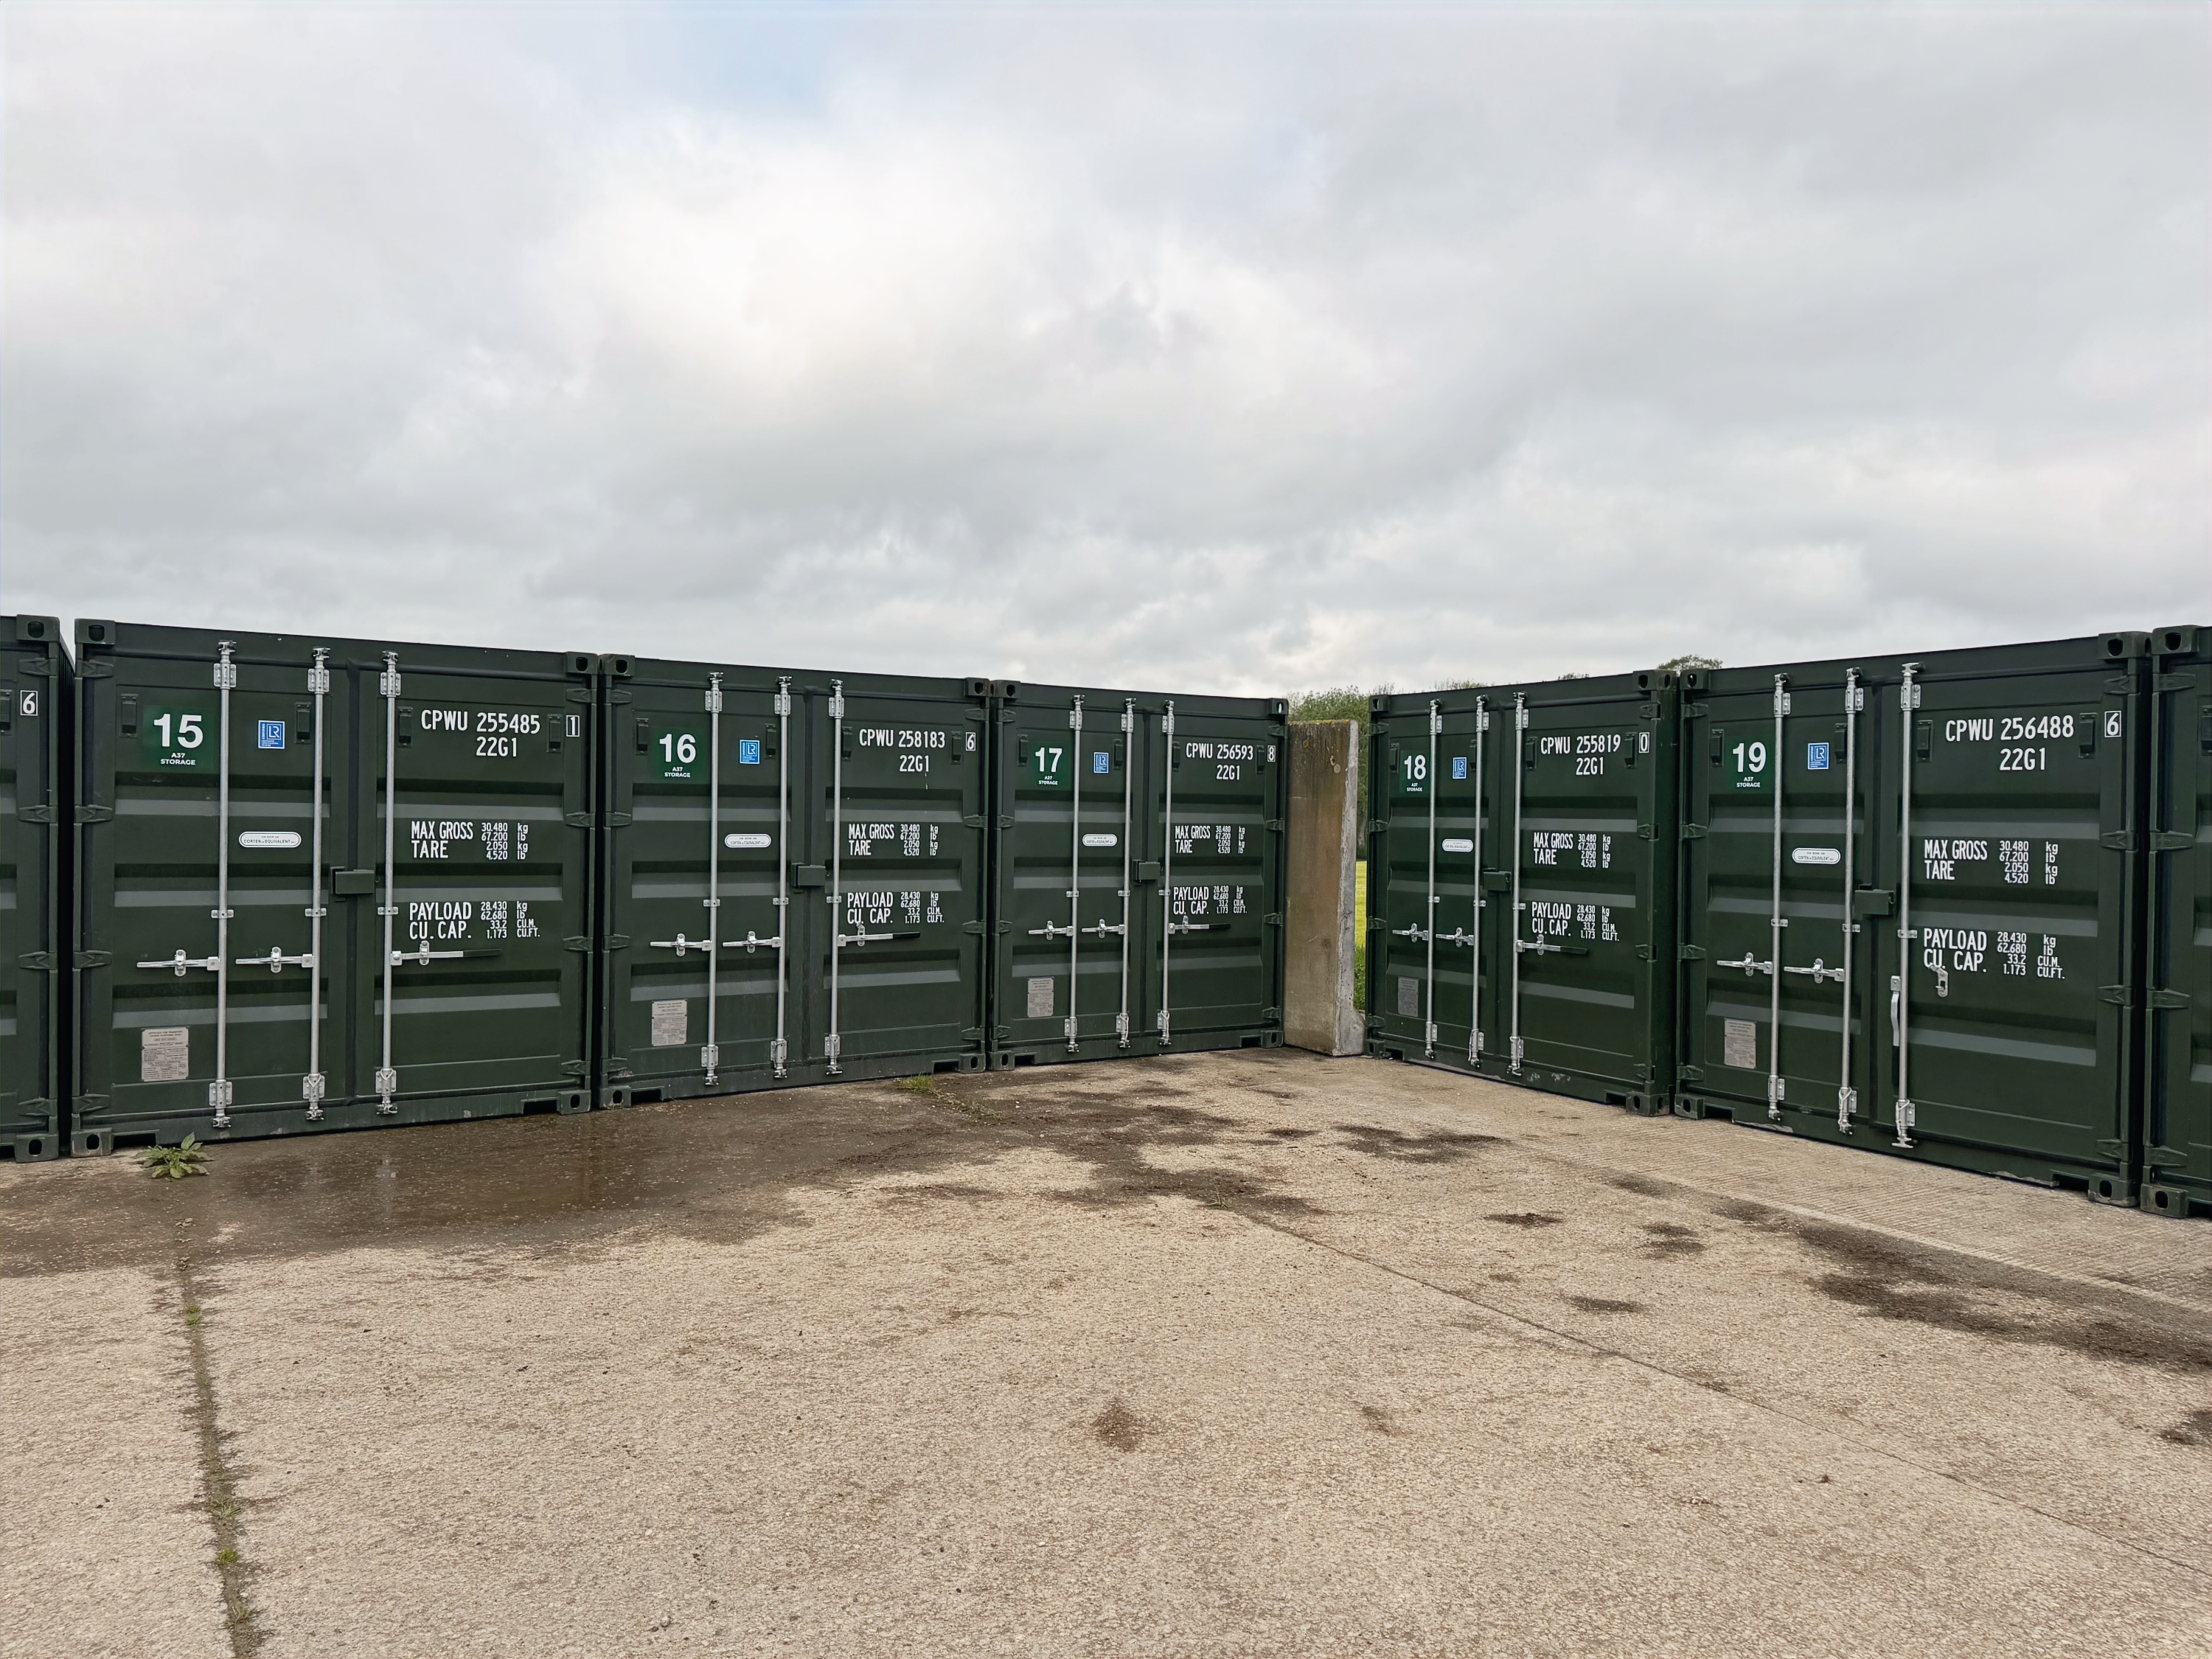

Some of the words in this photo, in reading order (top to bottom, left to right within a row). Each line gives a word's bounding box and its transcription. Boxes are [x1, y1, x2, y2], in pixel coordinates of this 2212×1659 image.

[23, 693, 35, 713] 6
[422, 710, 467, 731] CPWU
[477, 712, 540, 734] 255485
[570, 717, 576, 735] 1
[1946, 719, 1993, 741] CPWU
[2001, 715, 2073, 740] 256488
[2107, 713, 2119, 735] 6
[154, 714, 203, 748] 15
[476, 737, 516, 757] 22G1
[860, 729, 893, 746] CPWU
[899, 731, 945, 748] 258183
[967, 734, 975, 750] 6
[1541, 737, 1570, 754] CPWU
[1576, 734, 1621, 754] 255819
[1640, 733, 1648, 752] 0
[660, 734, 695, 763] 16
[1186, 743, 1212, 758] CPWU
[900, 755, 928, 772] 22G1
[1035, 748, 1062, 772] 17
[1733, 742, 1766, 772] 19
[2000, 748, 2045, 770] 22G1
[1217, 765, 1239, 780] 22G1
[1405, 755, 1426, 779] 18
[1576, 757, 1603, 775] 22G1
[411, 821, 435, 839] MAX
[439, 821, 473, 839] GROSS
[481, 823, 507, 831] 30.480
[518, 823, 528, 834] kg
[849, 824, 866, 839] MAX
[869, 824, 894, 839] GROSS
[931, 824, 938, 833] kg
[1175, 826, 1189, 838] MAX
[1191, 826, 1210, 838] GROSS
[1239, 826, 1245, 834] kg
[481, 832, 507, 841] 67.200
[518, 832, 526, 841] lb
[1534, 832, 1548, 847] MAX
[1551, 833, 1573, 849] GROSS
[1603, 835, 1610, 844] kg
[411, 841, 448, 858] TARE
[487, 841, 507, 850] 2.050
[518, 842, 528, 852] kg
[849, 840, 871, 855] TARE
[931, 841, 938, 849] kg
[1175, 840, 1192, 853] TARE
[1924, 840, 1948, 859] MAX
[1952, 841, 1987, 860] GROSS
[2000, 841, 2028, 851] 30.480
[2046, 841, 2058, 855] kg
[487, 851, 507, 860] 4.520
[518, 851, 526, 860] lb
[1534, 849, 1557, 864] TARE
[1603, 852, 1610, 861] kg
[2000, 852, 2028, 862] 67.200
[2046, 853, 2056, 863] lb
[1924, 860, 1955, 880] TARE
[2005, 863, 2028, 872] 2.050
[2045, 863, 2057, 876] kg
[2005, 873, 2028, 883] 4.520
[2046, 874, 2055, 884] lb
[901, 891, 920, 900] 28.430
[931, 891, 938, 900] kg
[1174, 887, 1208, 900] PAYLOAD
[1237, 886, 1242, 894] kg
[481, 901, 507, 911] 28.430
[517, 901, 527, 912] kg
[848, 892, 893, 908] PAYLOAD
[1174, 901, 1186, 914] CU.
[1191, 901, 1208, 914] CAP.
[410, 902, 471, 920] PAYLOAD
[481, 911, 507, 920] 62.680
[517, 911, 525, 919] lb
[847, 908, 863, 924] CU.
[870, 908, 892, 923] CAP.
[1532, 902, 1571, 919] PAYLOAD
[1602, 906, 1610, 916] kg
[410, 920, 434, 939] CU.
[438, 921, 471, 939] CAP.
[490, 920, 507, 929] 33.2
[1532, 918, 1547, 933] CU.
[1550, 919, 1571, 936] CAP.
[487, 929, 507, 939] 1.173
[1924, 928, 1986, 951] PAYLOAD
[1997, 932, 2026, 943] 28.430
[2044, 934, 2056, 947] kg
[1997, 943, 2026, 953] 62.680
[2044, 945, 2053, 956] lb
[1924, 949, 1945, 970] CU.
[1954, 951, 1986, 972] CAP.
[2008, 954, 2026, 964] 33.2
[2003, 964, 2025, 975] 1.173
